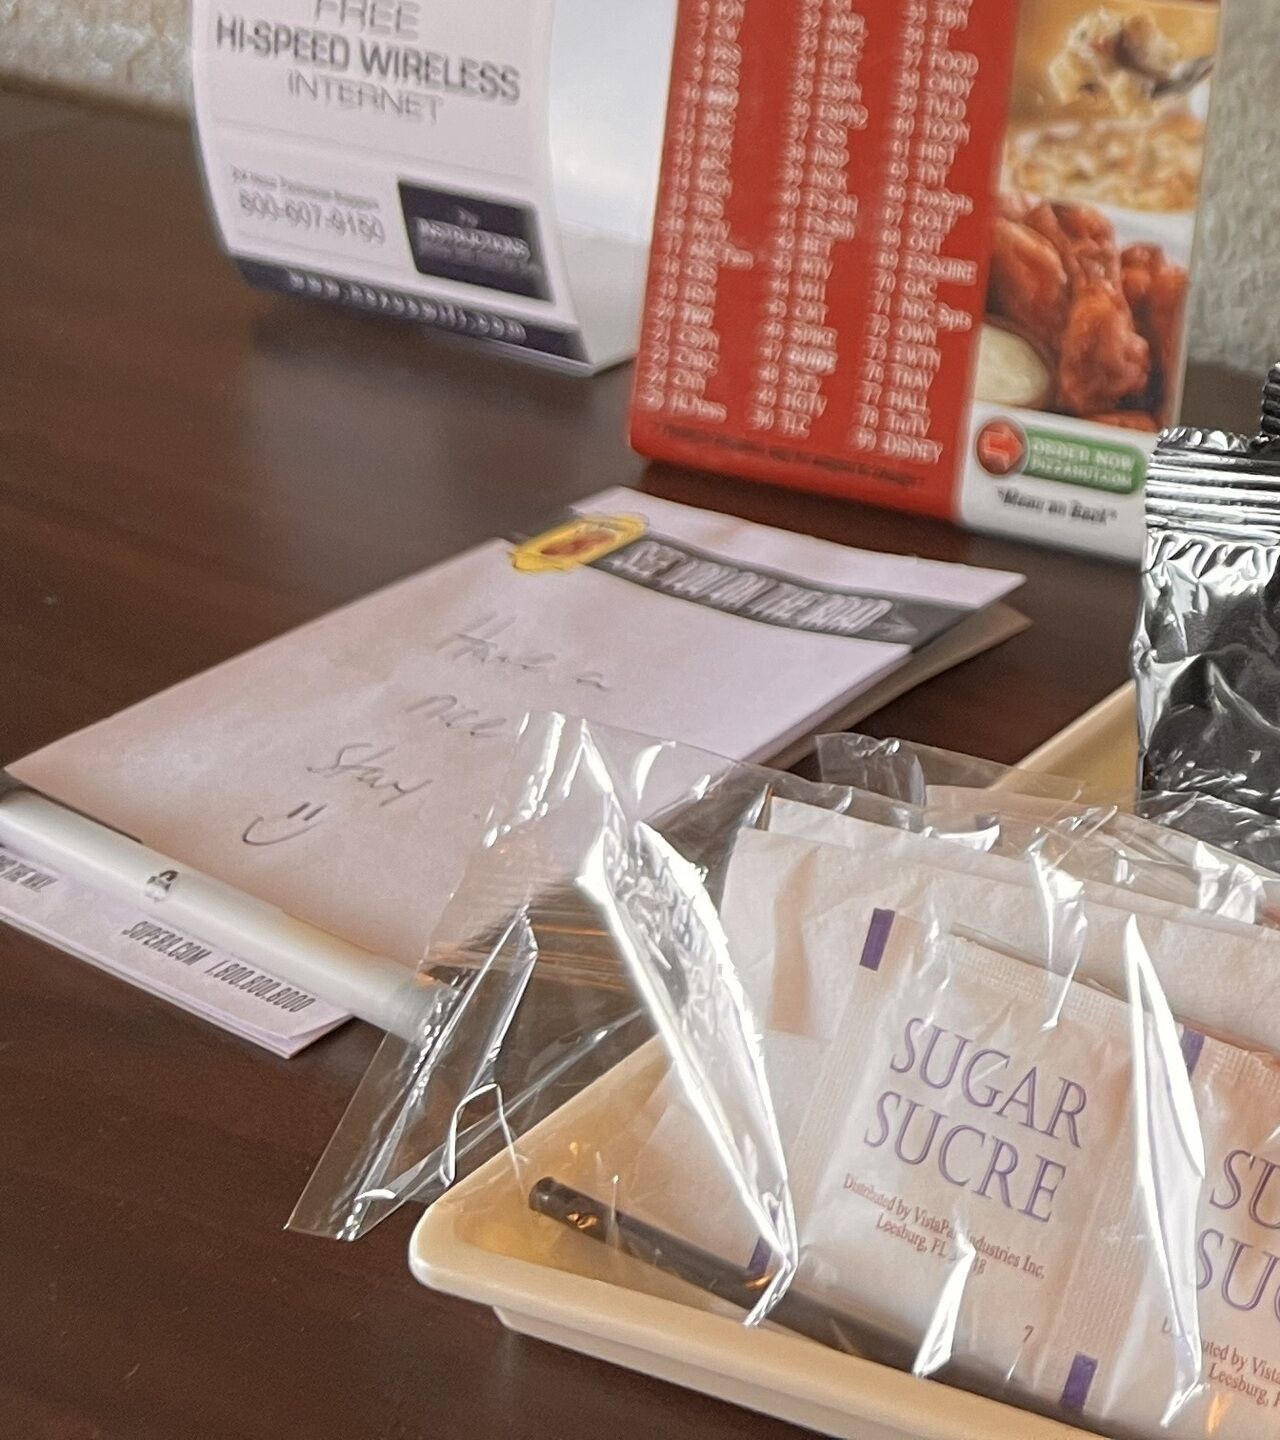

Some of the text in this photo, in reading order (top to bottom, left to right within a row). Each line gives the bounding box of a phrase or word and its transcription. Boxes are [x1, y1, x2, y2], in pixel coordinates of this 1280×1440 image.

[216, 12, 521, 106] HI-SPEED WIRELESS
[287, 70, 446, 126] INTERNET
[890, 1015, 1090, 1152] SUGAR
[863, 1089, 1068, 1225] SUCRE
[843, 1173, 897, 1211] Distributed
[898, 1199, 912, 1221] by
[914, 1206, 955, 1240] VistaPa
[967, 1231, 1021, 1267] ndustries
[876, 1212, 947, 1258] Leesburg, FL
[1208, 1363, 1270, 1407] Leesburg,
[1230, 1346, 1248, 1372] by
